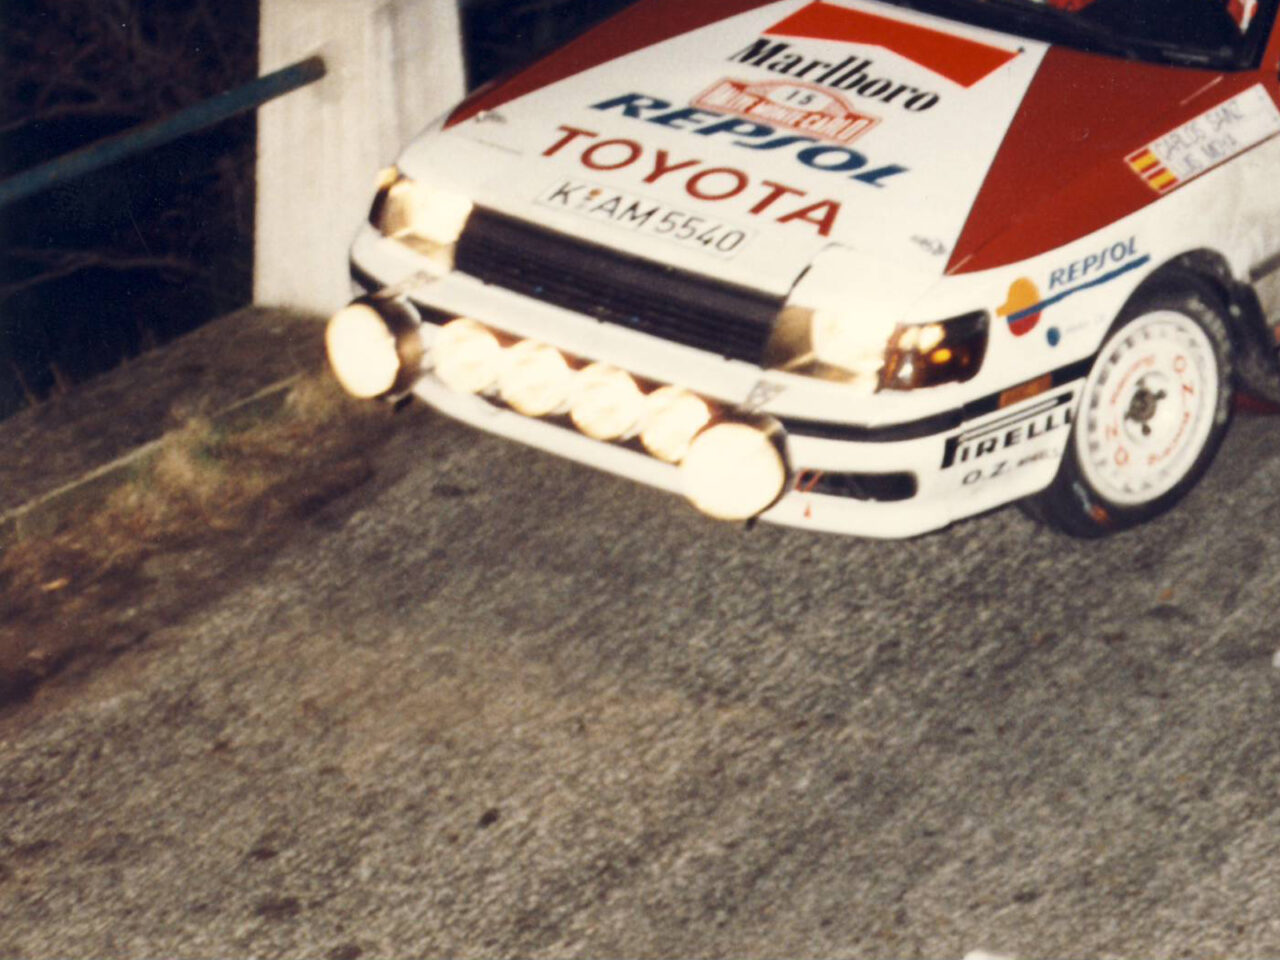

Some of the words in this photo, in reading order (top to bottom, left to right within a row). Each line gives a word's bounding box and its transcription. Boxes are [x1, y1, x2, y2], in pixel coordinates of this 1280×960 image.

[726, 37, 941, 113] Marlboro
[786, 89, 817, 106] 15
[589, 92, 910, 188] REPSOL
[541, 124, 843, 238] TOYOTA
[1048, 235, 1139, 291] REPSOL
[940, 390, 1073, 470] PIRELLI
